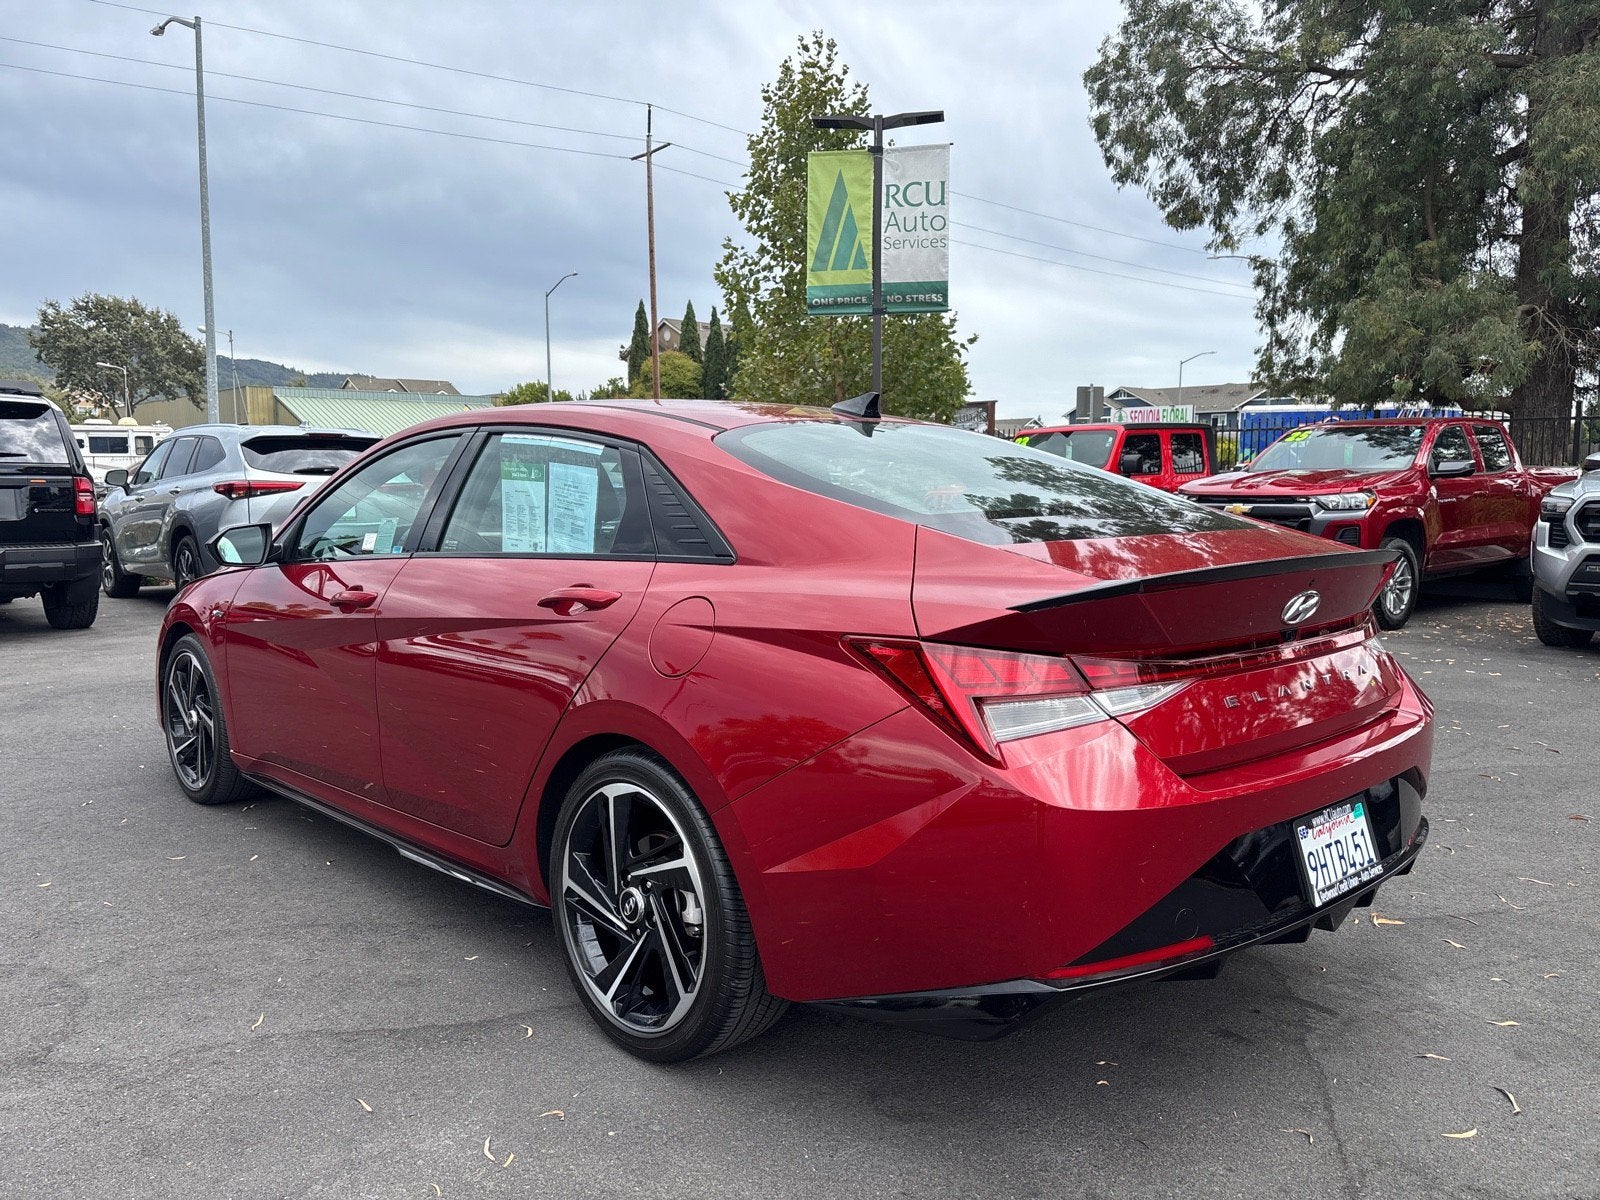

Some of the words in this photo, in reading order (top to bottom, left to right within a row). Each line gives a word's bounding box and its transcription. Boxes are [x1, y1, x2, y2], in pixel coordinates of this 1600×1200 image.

[884, 180, 946, 209] RCU
[884, 211, 947, 234] Auto
[884, 236, 947, 250] Services
[812, 297, 834, 306] ONE
[837, 296, 868, 305] PRICE
[886, 294, 904, 303] NO
[907, 293, 944, 302] STRESS
[1130, 409, 1160, 422] SEQUOIA
[1162, 407, 1188, 422] FLORAL
[1223, 665, 1368, 709] ELANTRA
[1307, 828, 1374, 889] 9HTB451
